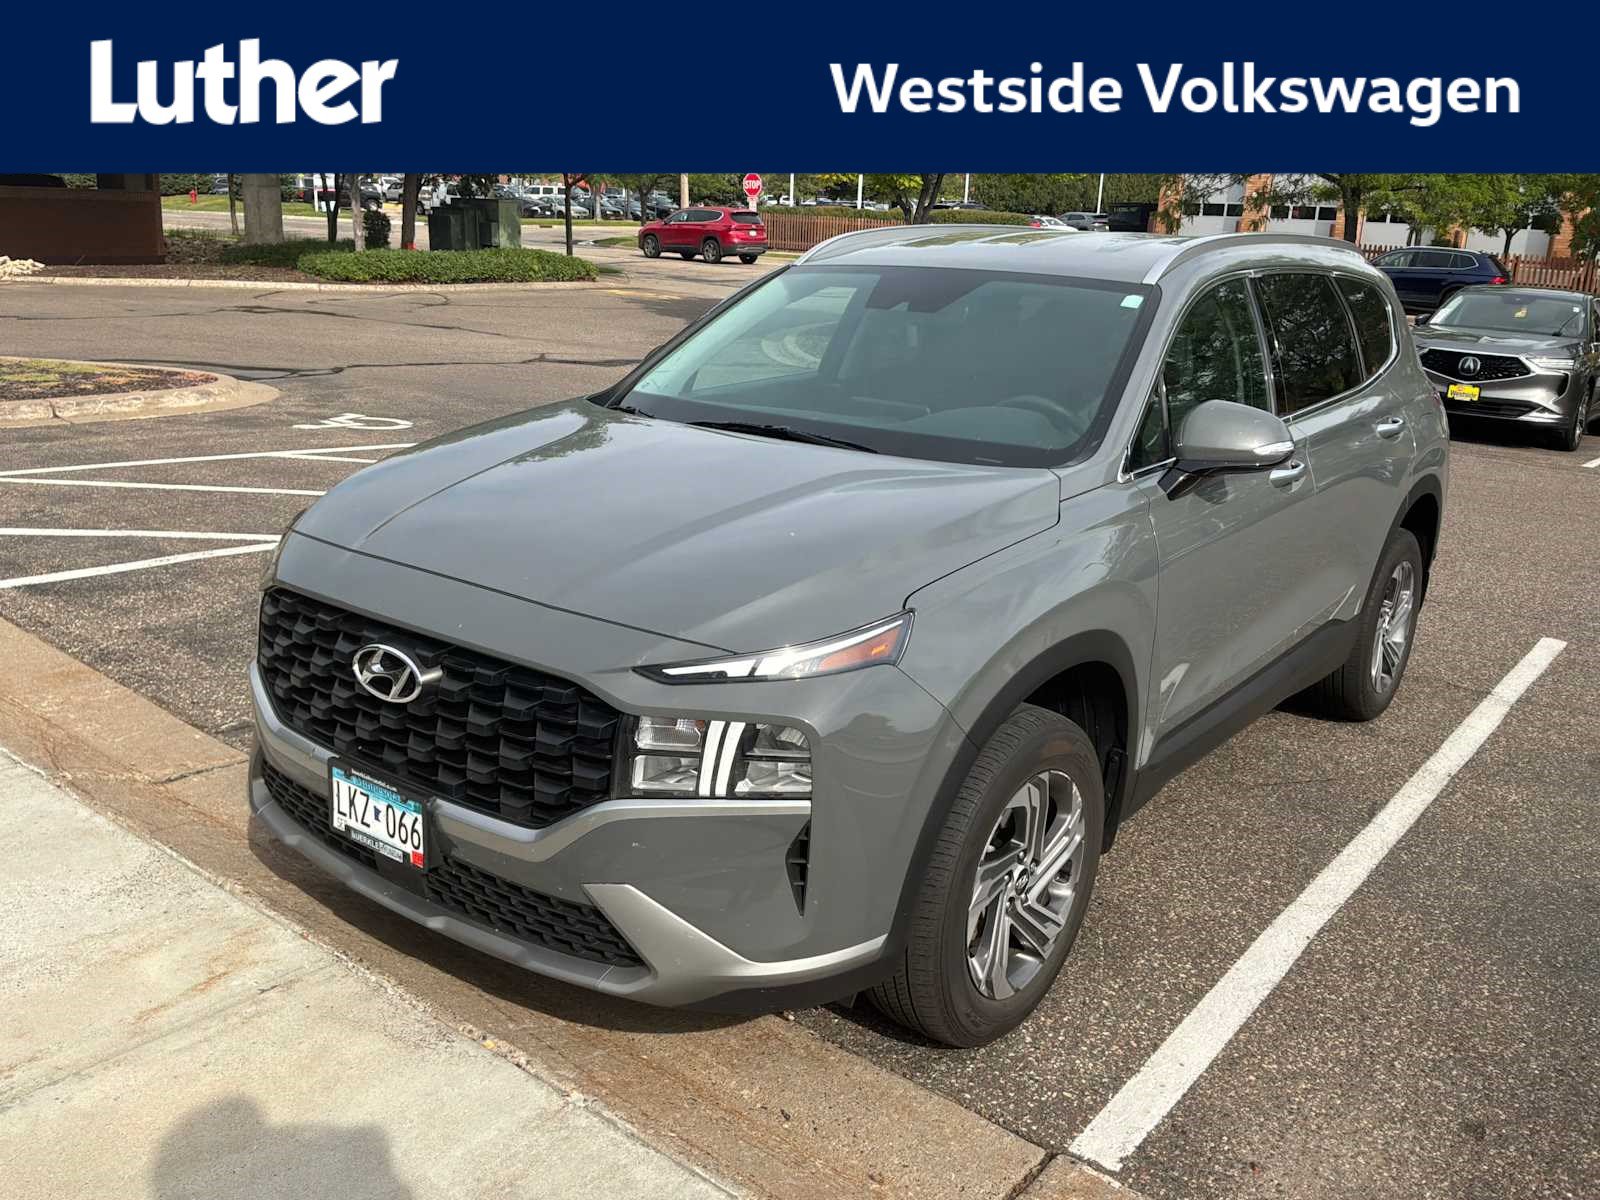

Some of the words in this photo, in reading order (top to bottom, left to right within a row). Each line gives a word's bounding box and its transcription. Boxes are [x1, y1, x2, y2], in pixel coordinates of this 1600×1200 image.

[745, 179, 760, 189] STOP
[336, 780, 371, 828] LKZ
[385, 803, 421, 850] 066
